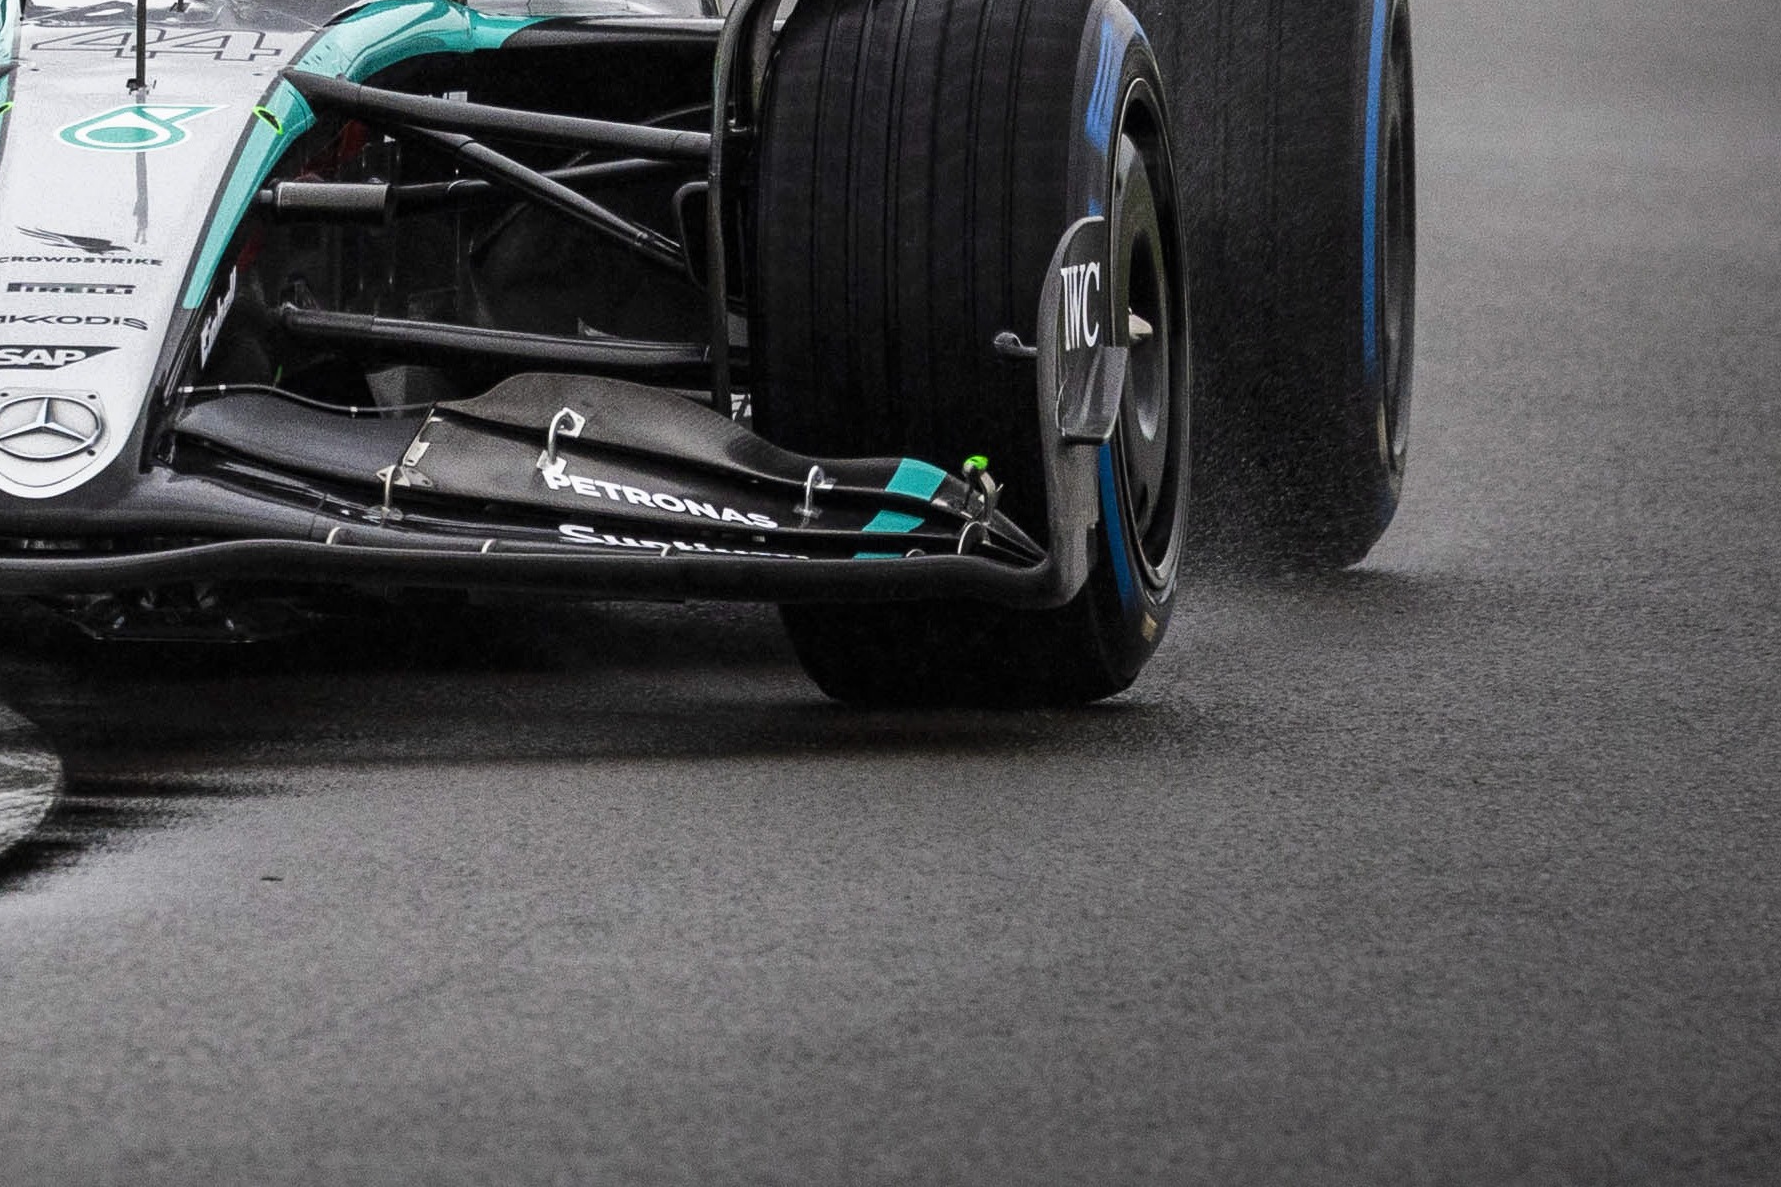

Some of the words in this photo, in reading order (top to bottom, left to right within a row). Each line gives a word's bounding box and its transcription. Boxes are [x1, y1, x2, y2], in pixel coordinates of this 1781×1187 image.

[31, 25, 282, 62] 44
[1060, 262, 1100, 352] IWC
[543, 470, 779, 530] PETRONAS
